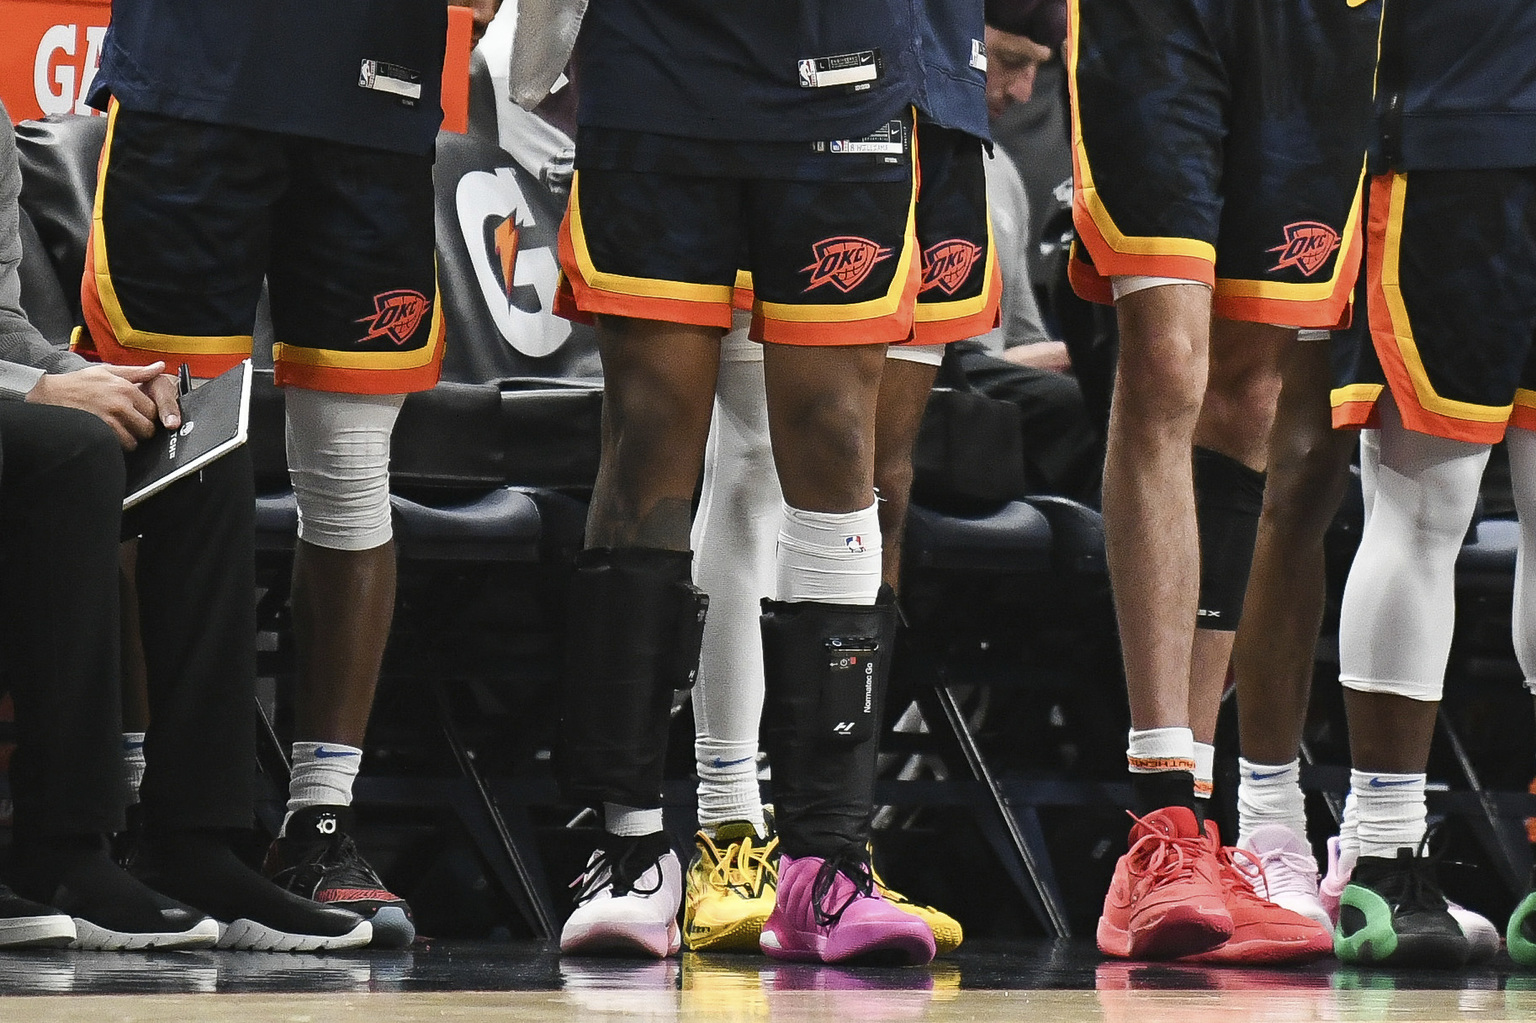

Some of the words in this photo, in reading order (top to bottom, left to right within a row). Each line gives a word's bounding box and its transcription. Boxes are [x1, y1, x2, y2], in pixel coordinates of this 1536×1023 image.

[813, 247, 865, 280] OKC
[923, 248, 965, 284] OKC
[372, 301, 417, 331] OKC
[865, 662, 873, 674] Go
[863, 675, 873, 713] Normatec
